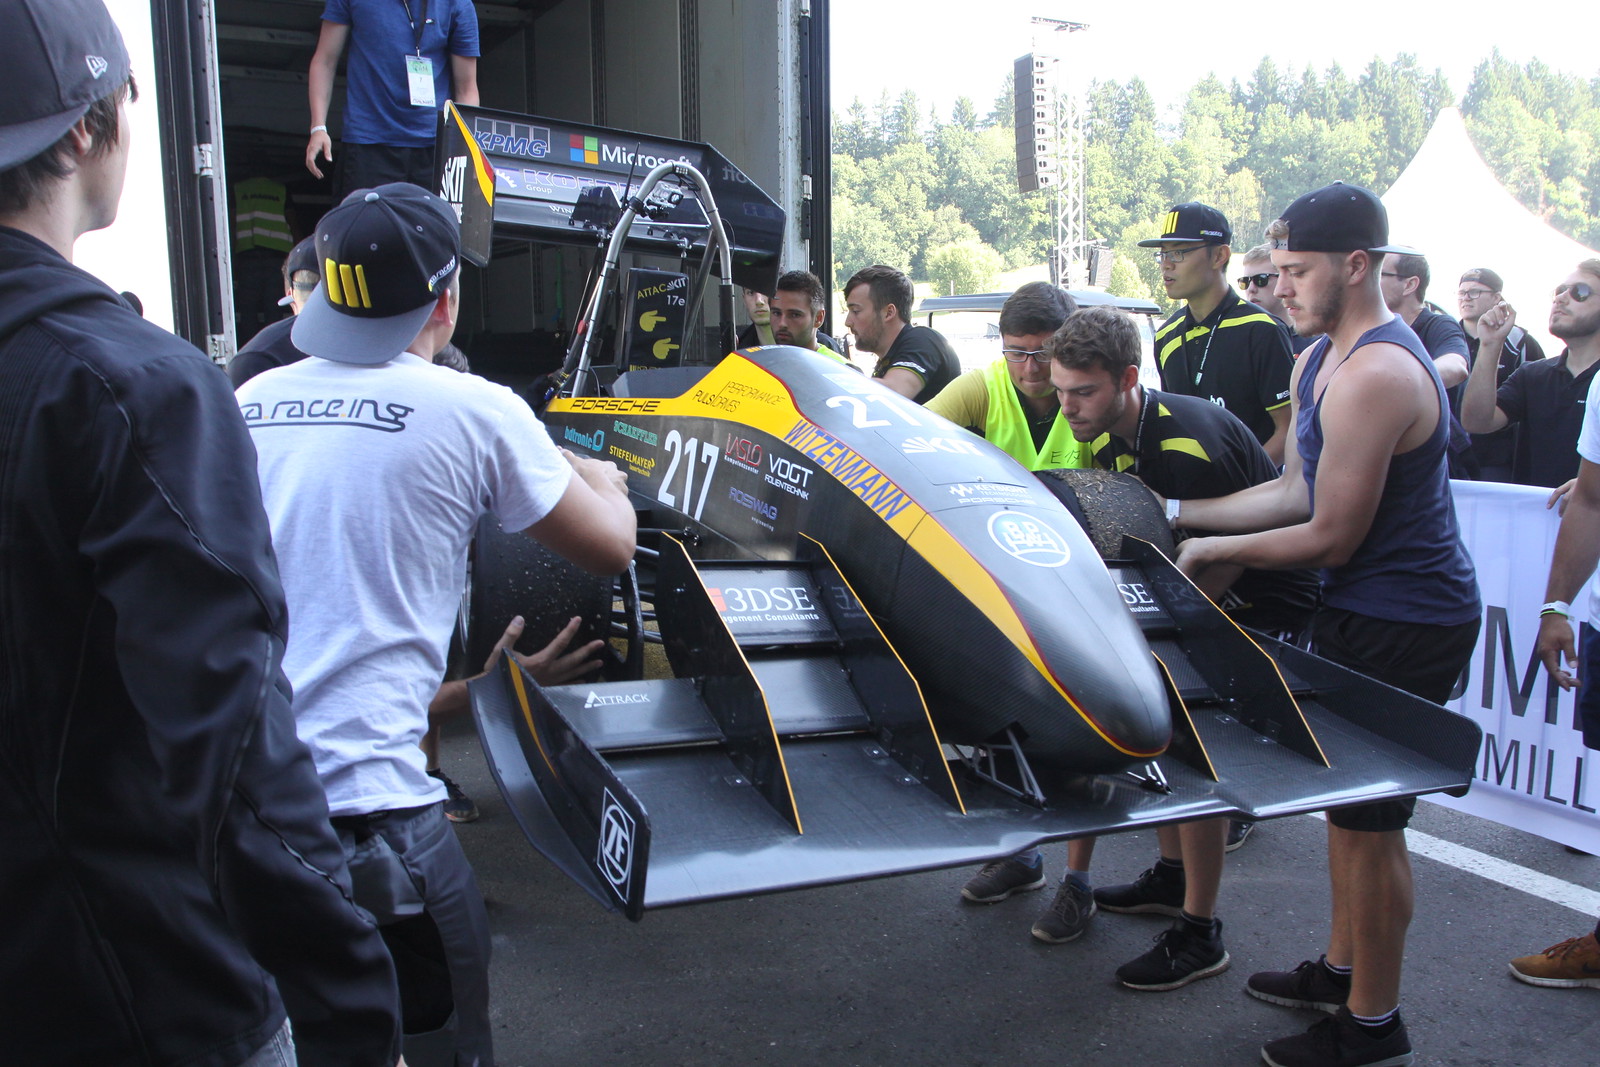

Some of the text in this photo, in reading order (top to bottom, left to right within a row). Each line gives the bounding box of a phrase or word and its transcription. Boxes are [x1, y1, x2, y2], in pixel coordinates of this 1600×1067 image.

[473, 131, 548, 158] KPMG
[602, 144, 692, 169] Microsft
[525, 184, 553, 195] Group
[667, 294, 686, 306] 17e
[570, 399, 661, 412] PORSCHE
[564, 425, 593, 449] bdtronic
[609, 445, 652, 471] STIEFELMAYER
[769, 453, 814, 488] VOGT
[783, 419, 912, 522] WITZENMANN
[657, 429, 720, 522] 217
[764, 473, 809, 501] FOLIENTECHNIK
[724, 587, 815, 612] 3DSE
[765, 613, 820, 622] Consultants
[584, 690, 651, 708] ATTRACK
